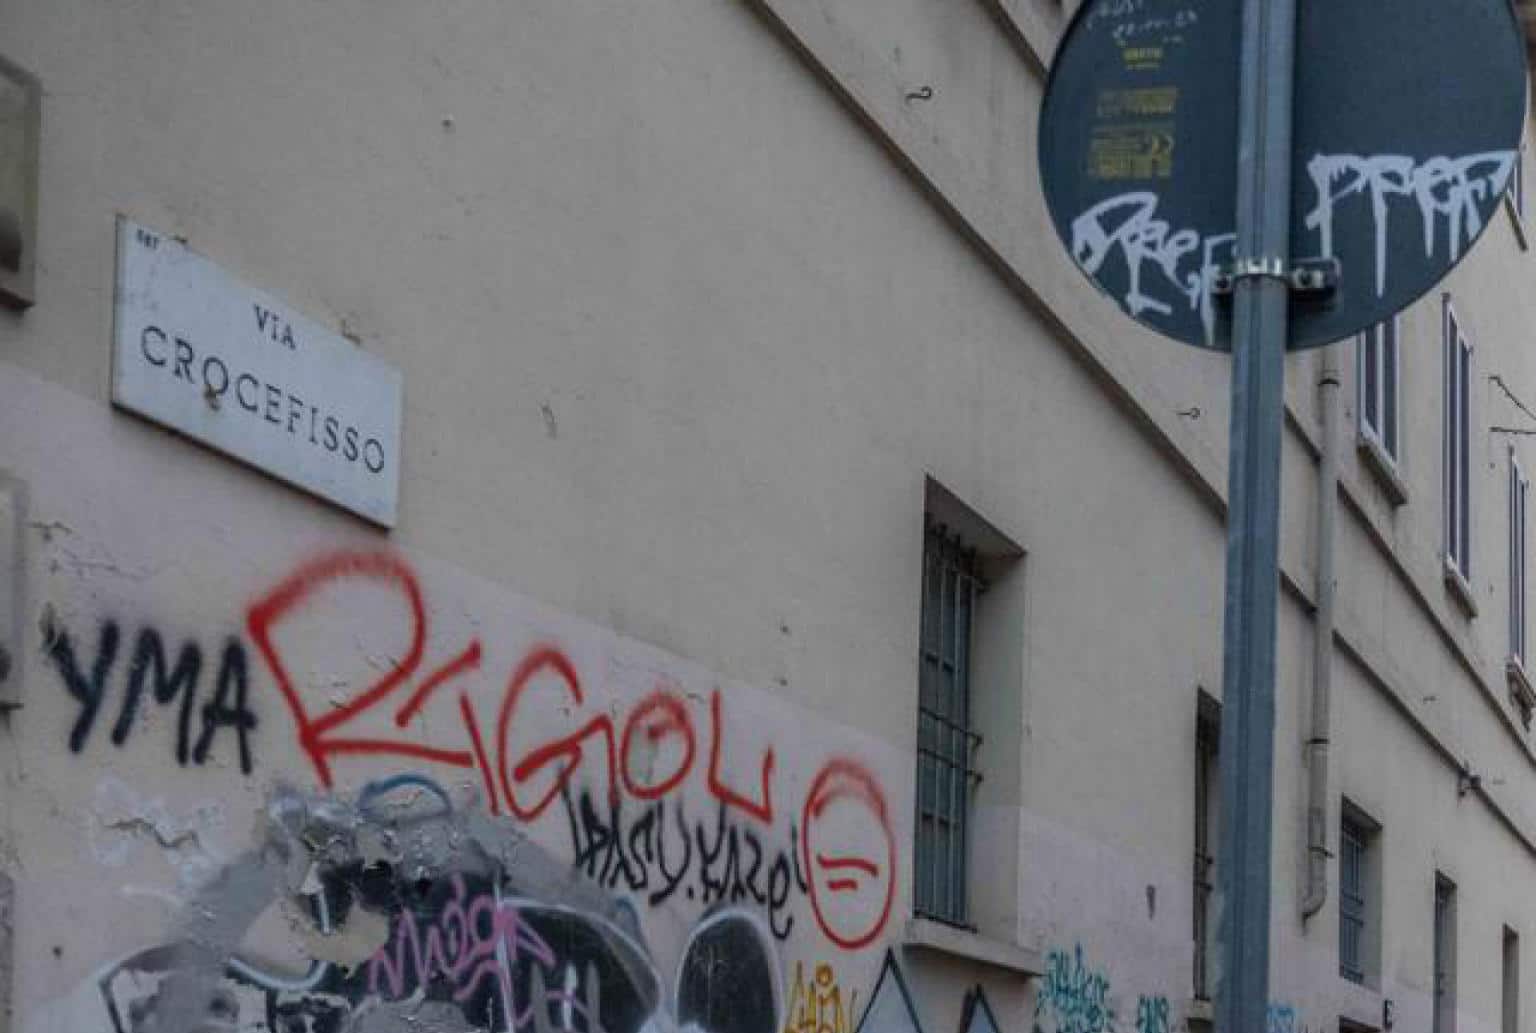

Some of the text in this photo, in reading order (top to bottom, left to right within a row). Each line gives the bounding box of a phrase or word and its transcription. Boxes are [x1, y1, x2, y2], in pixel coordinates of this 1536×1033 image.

[140, 324, 386, 475] CROCEFISSO
[253, 302, 298, 352] VIA
[40, 605, 257, 776] YMA
